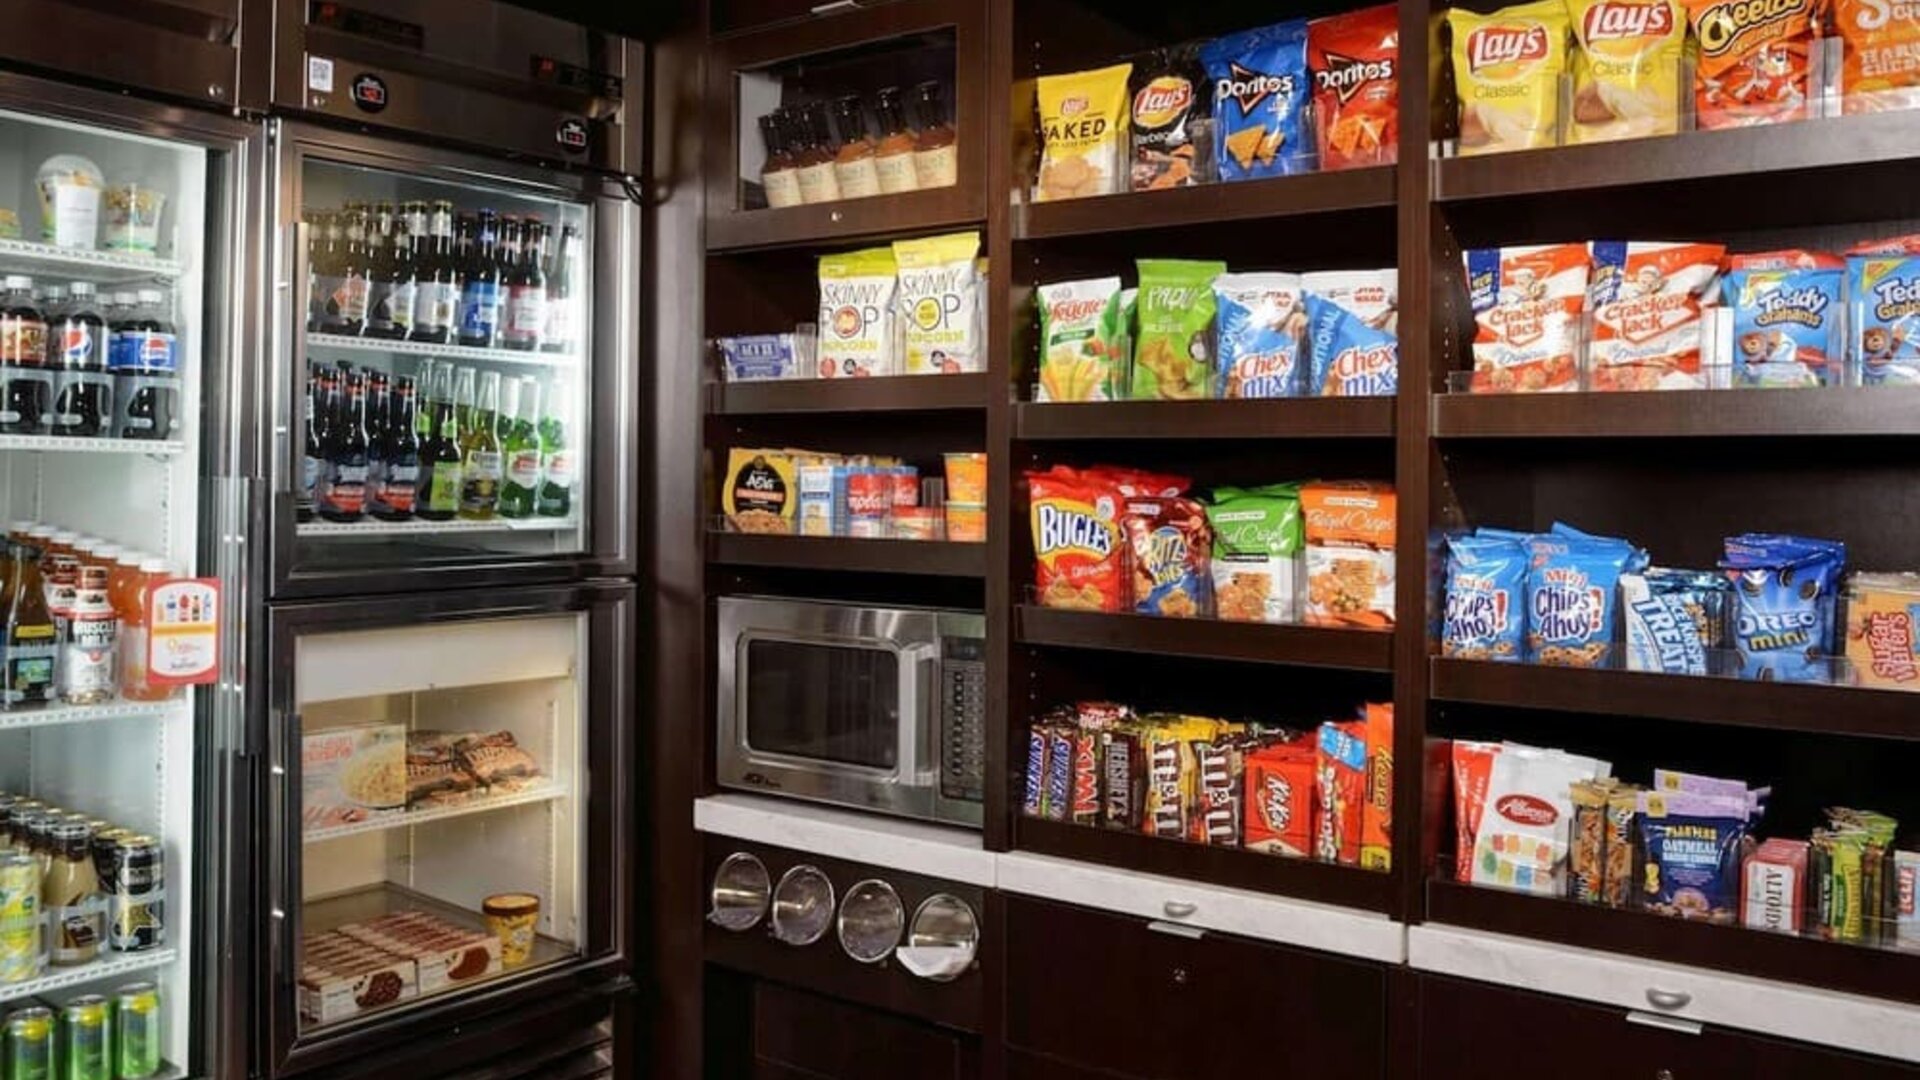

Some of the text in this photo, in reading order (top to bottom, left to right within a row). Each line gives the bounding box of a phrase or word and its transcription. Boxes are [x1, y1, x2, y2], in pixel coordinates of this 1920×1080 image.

[1587, 1, 1672, 38] Lay's
[1471, 29, 1543, 66] Lay's
[1316, 58, 1392, 88] Doritos
[1136, 82, 1190, 114] Lay's
[1218, 75, 1293, 99] Doritos
[1474, 84, 1532, 98] Classic
[823, 284, 883, 304] SKINNY
[902, 270, 961, 296] SKINNY
[1605, 295, 1685, 321] Cracker
[1760, 288, 1826, 313] Teddy
[1757, 309, 1822, 327] Grahams
[1239, 352, 1289, 379] Chex
[1338, 346, 1392, 377] Chex
[1039, 505, 1111, 554] BUGLES
[1446, 593, 1494, 620] Chips
[1536, 588, 1590, 616] Chips
[1738, 612, 1816, 634] OREO
[1750, 629, 1809, 651] mini
[1027, 732, 1044, 808] SNICKERS
[1108, 740, 1128, 818] HERSHEY'S
[1662, 839, 1718, 853] OATMEAL
